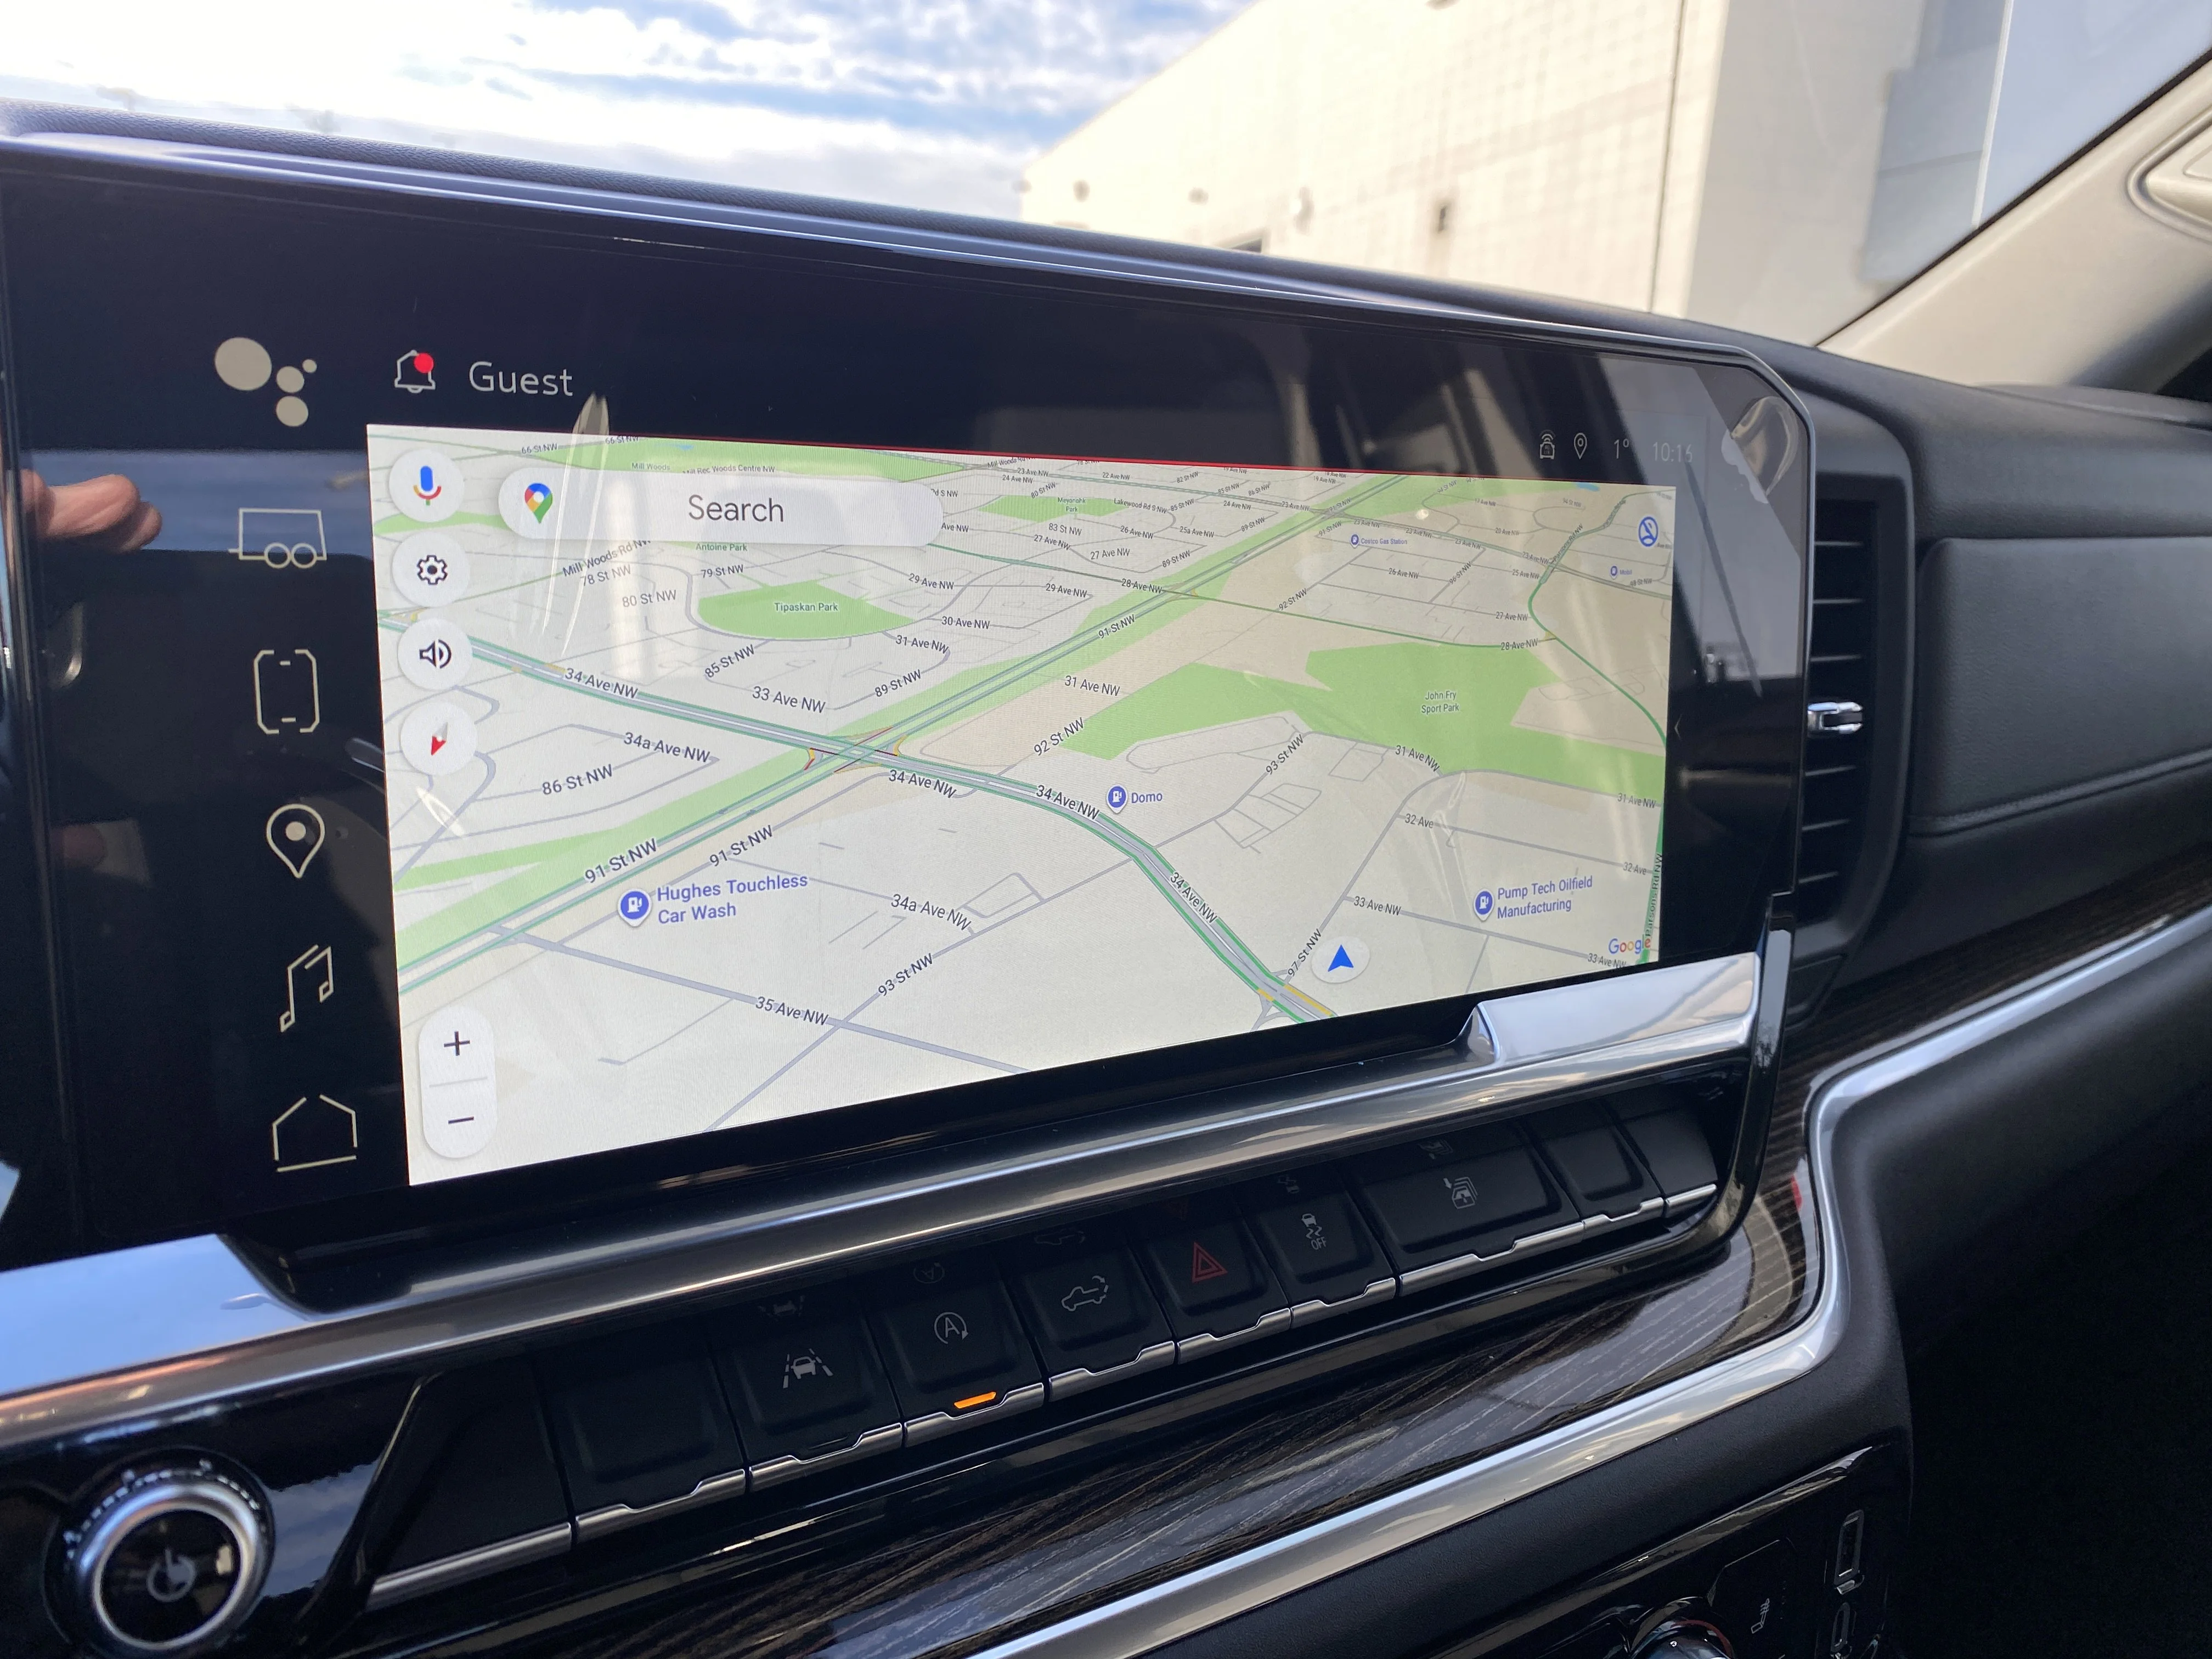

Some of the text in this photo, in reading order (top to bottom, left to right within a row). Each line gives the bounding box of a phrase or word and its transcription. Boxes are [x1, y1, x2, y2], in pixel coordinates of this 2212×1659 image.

[469, 361, 573, 396] Guest
[1614, 439, 1693, 462] 1° 10:16
[1114, 498, 1142, 509] Lakewood
[1143, 501, 1151, 510] Rd
[1157, 505, 1167, 514] NW
[1048, 522, 1082, 537] 83 St NW
[1120, 525, 1154, 540] 26 Ave NW
[1034, 534, 1071, 551] 27 Ave NW
[1090, 547, 1131, 560] 27 Ave NW
[700, 564, 745, 579] 79 St NW
[908, 573, 955, 590] 29 Ave NW
[1388, 567, 1420, 579] 26 Ave NW
[1045, 583, 1088, 599] 29 Ave NW
[1121, 578, 1163, 594] 28 Ave NW
[622, 589, 677, 608] 80 St NW
[774, 602, 839, 612] Tipaskan Park
[1279, 588, 1308, 612] 92 St NW
[941, 616, 990, 630] 30 Ave NW
[1098, 613, 1136, 639] 91 St NW
[1496, 611, 1529, 622] 27 Ave NW
[895, 634, 949, 654] 31 Ave NW
[1500, 637, 1539, 651] 28 Ave NW
[704, 644, 755, 678] 85 St NW
[564, 667, 639, 699] 34 Ave NW
[874, 669, 922, 697] 89 St NW
[1064, 675, 1121, 697] 31 Ave NW
[752, 685, 827, 714] 33 Ave NW
[1425, 690, 1457, 701] John Fry
[1421, 703, 1460, 715] Sport Park
[623, 731, 711, 764] 34a Ave NW
[1034, 716, 1085, 757] 92 St NW
[1266, 733, 1304, 775] 93 St NW
[1395, 744, 1441, 773] 31 Ave NW
[541, 763, 613, 795] 86 St NW
[888, 769, 957, 799] 34 Ave NW
[1036, 785, 1101, 821] 34 Ave NW
[1131, 792, 1163, 804] Domo
[1617, 792, 1657, 809] 31 Ave NW
[1404, 813, 1434, 829] 32 Ave
[709, 824, 774, 867] 91 St NW
[584, 837, 657, 884] 91 St NW
[657, 874, 808, 903] Hughes Touchless
[1170, 871, 1218, 924] 34 Ave NW
[1497, 874, 1593, 900] Pump Tech Oilfield
[1644, 853, 1663, 937] Parsons Rd NW
[658, 901, 737, 924] Car Wash
[890, 893, 972, 931] 34a Ave NW
[1353, 895, 1402, 917] 33 Ave NW
[1497, 898, 1572, 919] Manufacturing
[1287, 928, 1323, 978] 97 St NW
[1608, 937, 1651, 955] Google
[877, 952, 934, 997] 93 St NW
[755, 995, 830, 1026] 35 Ave NW
[1311, 1235, 1327, 1251] OFF
